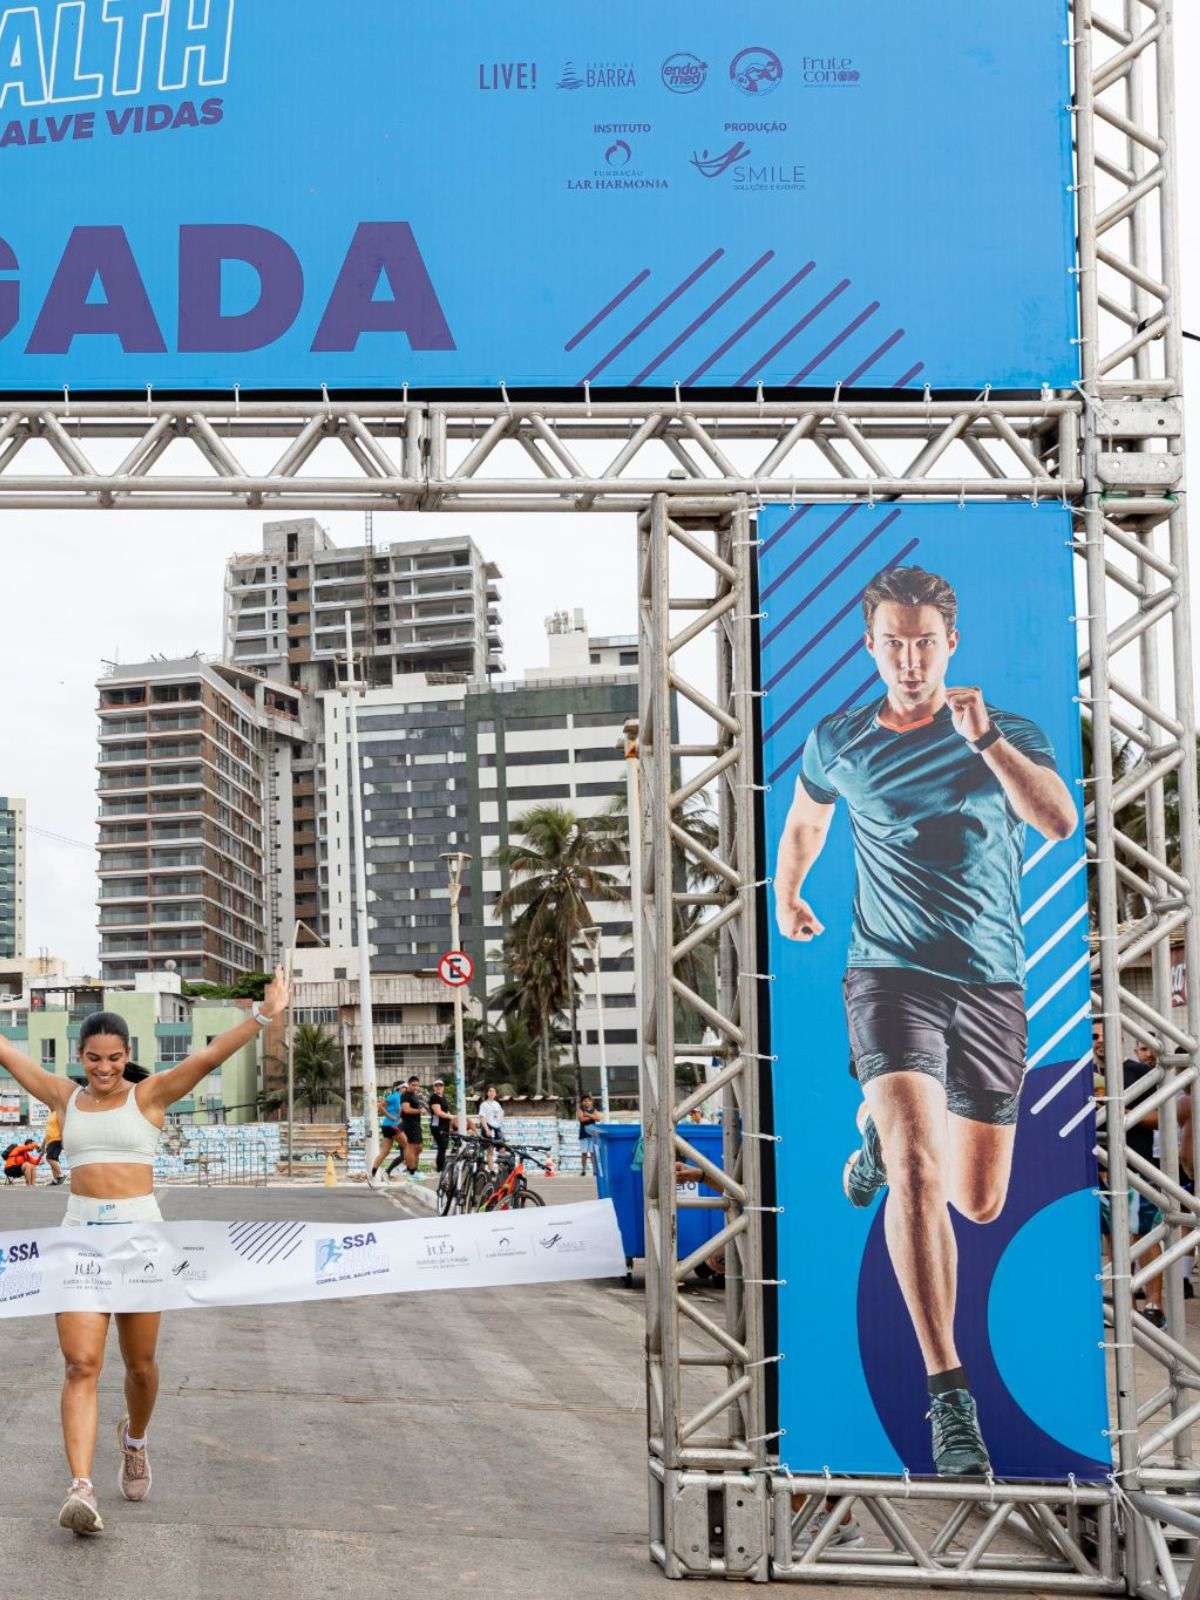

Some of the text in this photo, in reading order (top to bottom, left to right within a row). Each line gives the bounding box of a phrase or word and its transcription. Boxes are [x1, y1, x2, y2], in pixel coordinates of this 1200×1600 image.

[479, 63, 537, 90] LIVE!
[586, 69, 637, 88] BARRA
[106, 98, 224, 136] VIDAS
[593, 123, 651, 133] INSTITUTO
[724, 121, 787, 133] PRODUÇÃO
[734, 166, 806, 182] SMILE
[568, 179, 668, 189] LAR HARMONIA
[342, 1231, 377, 1249] SSA
[8, 1241, 40, 1263] SSA
